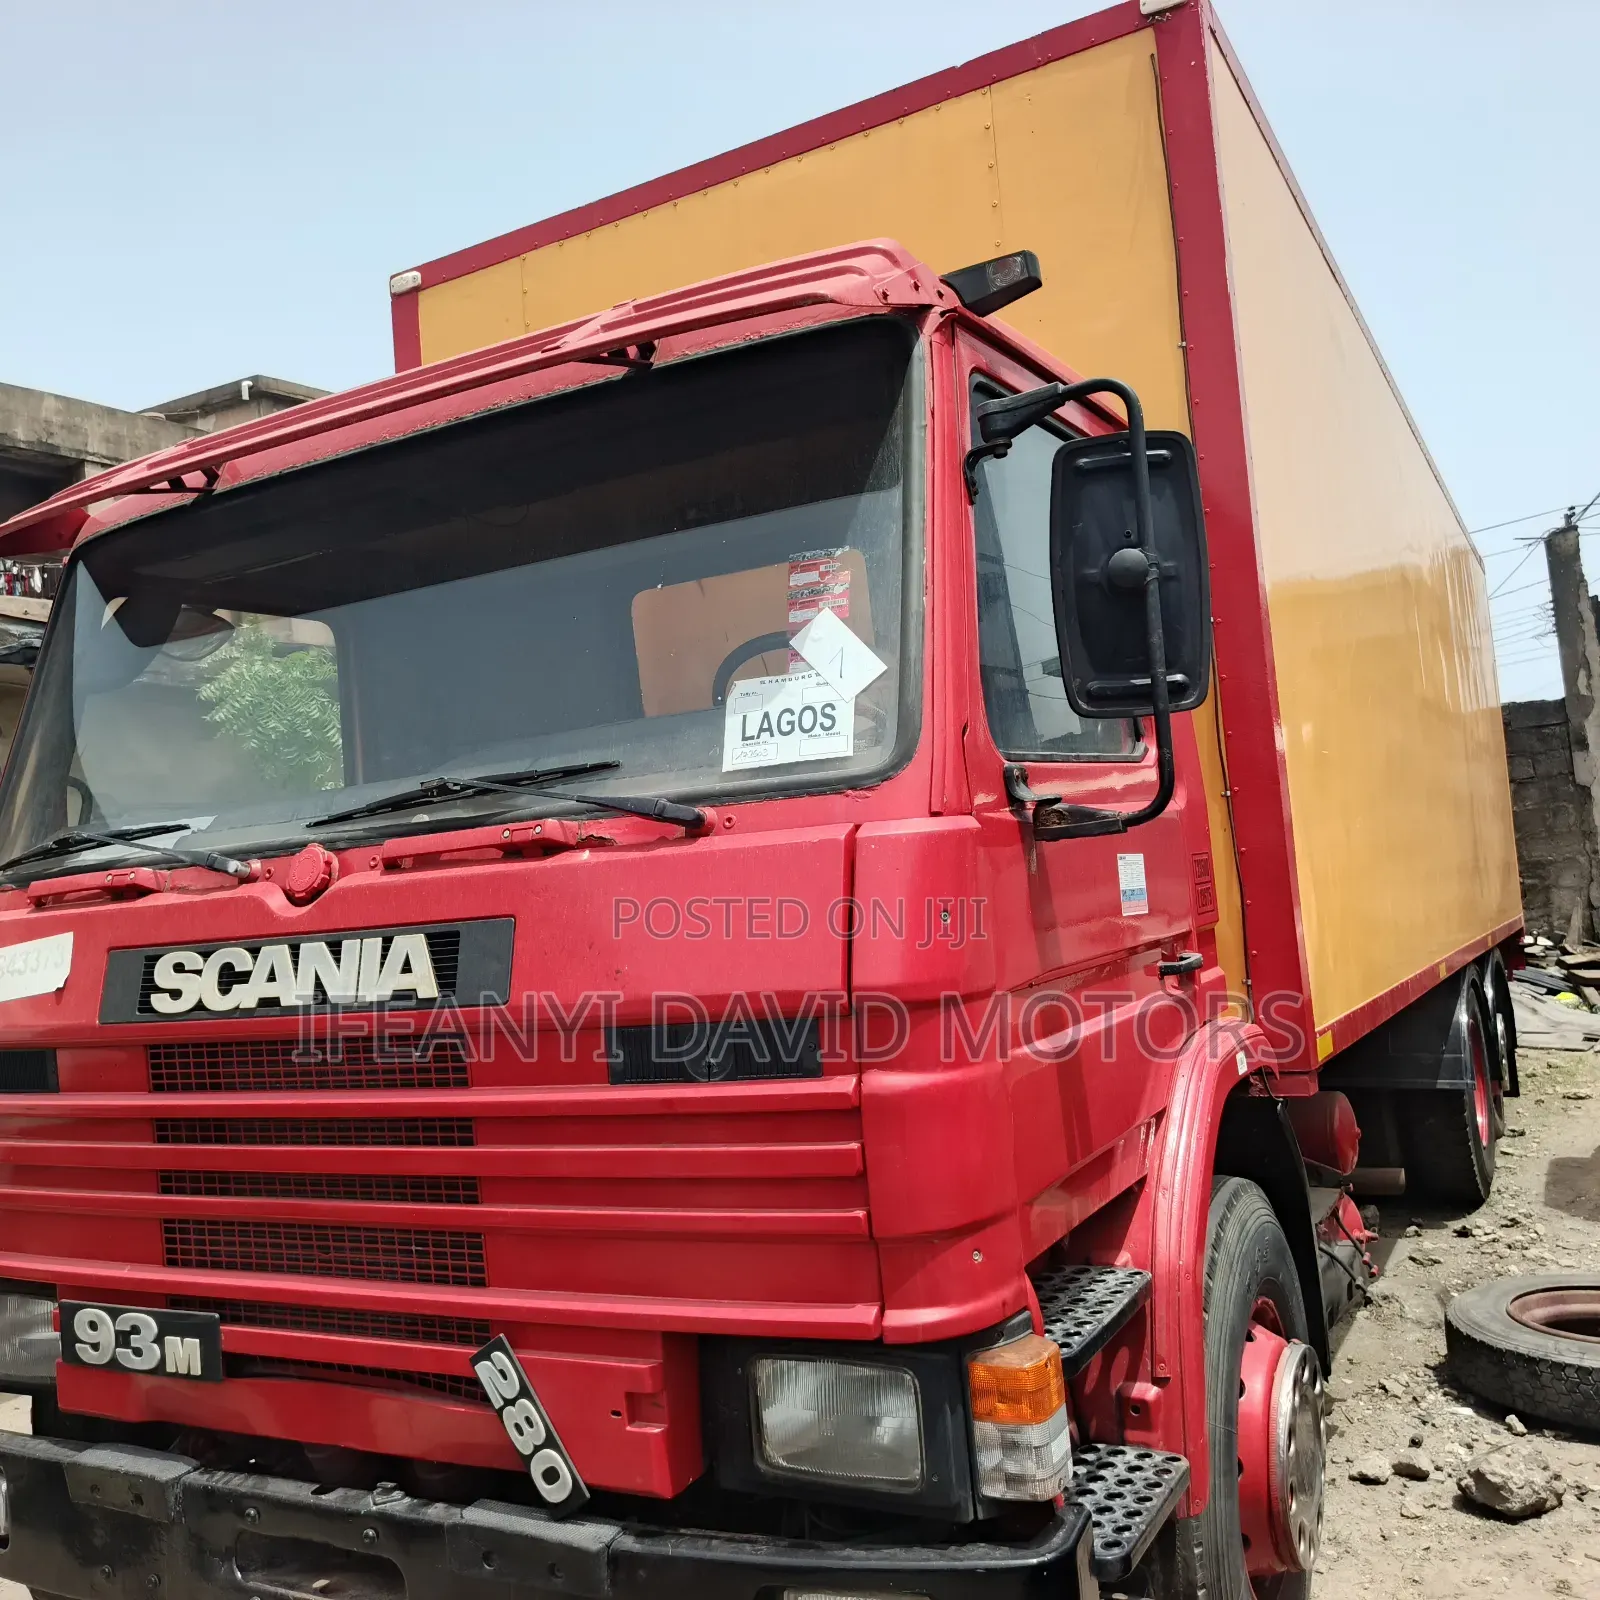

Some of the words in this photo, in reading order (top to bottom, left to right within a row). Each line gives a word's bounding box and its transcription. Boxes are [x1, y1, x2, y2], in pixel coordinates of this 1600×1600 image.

[828, 646, 844, 678] 1
[741, 702, 836, 742] LAGOS
[150, 933, 439, 1014] SCANIA
[474, 1351, 572, 1503] 280
